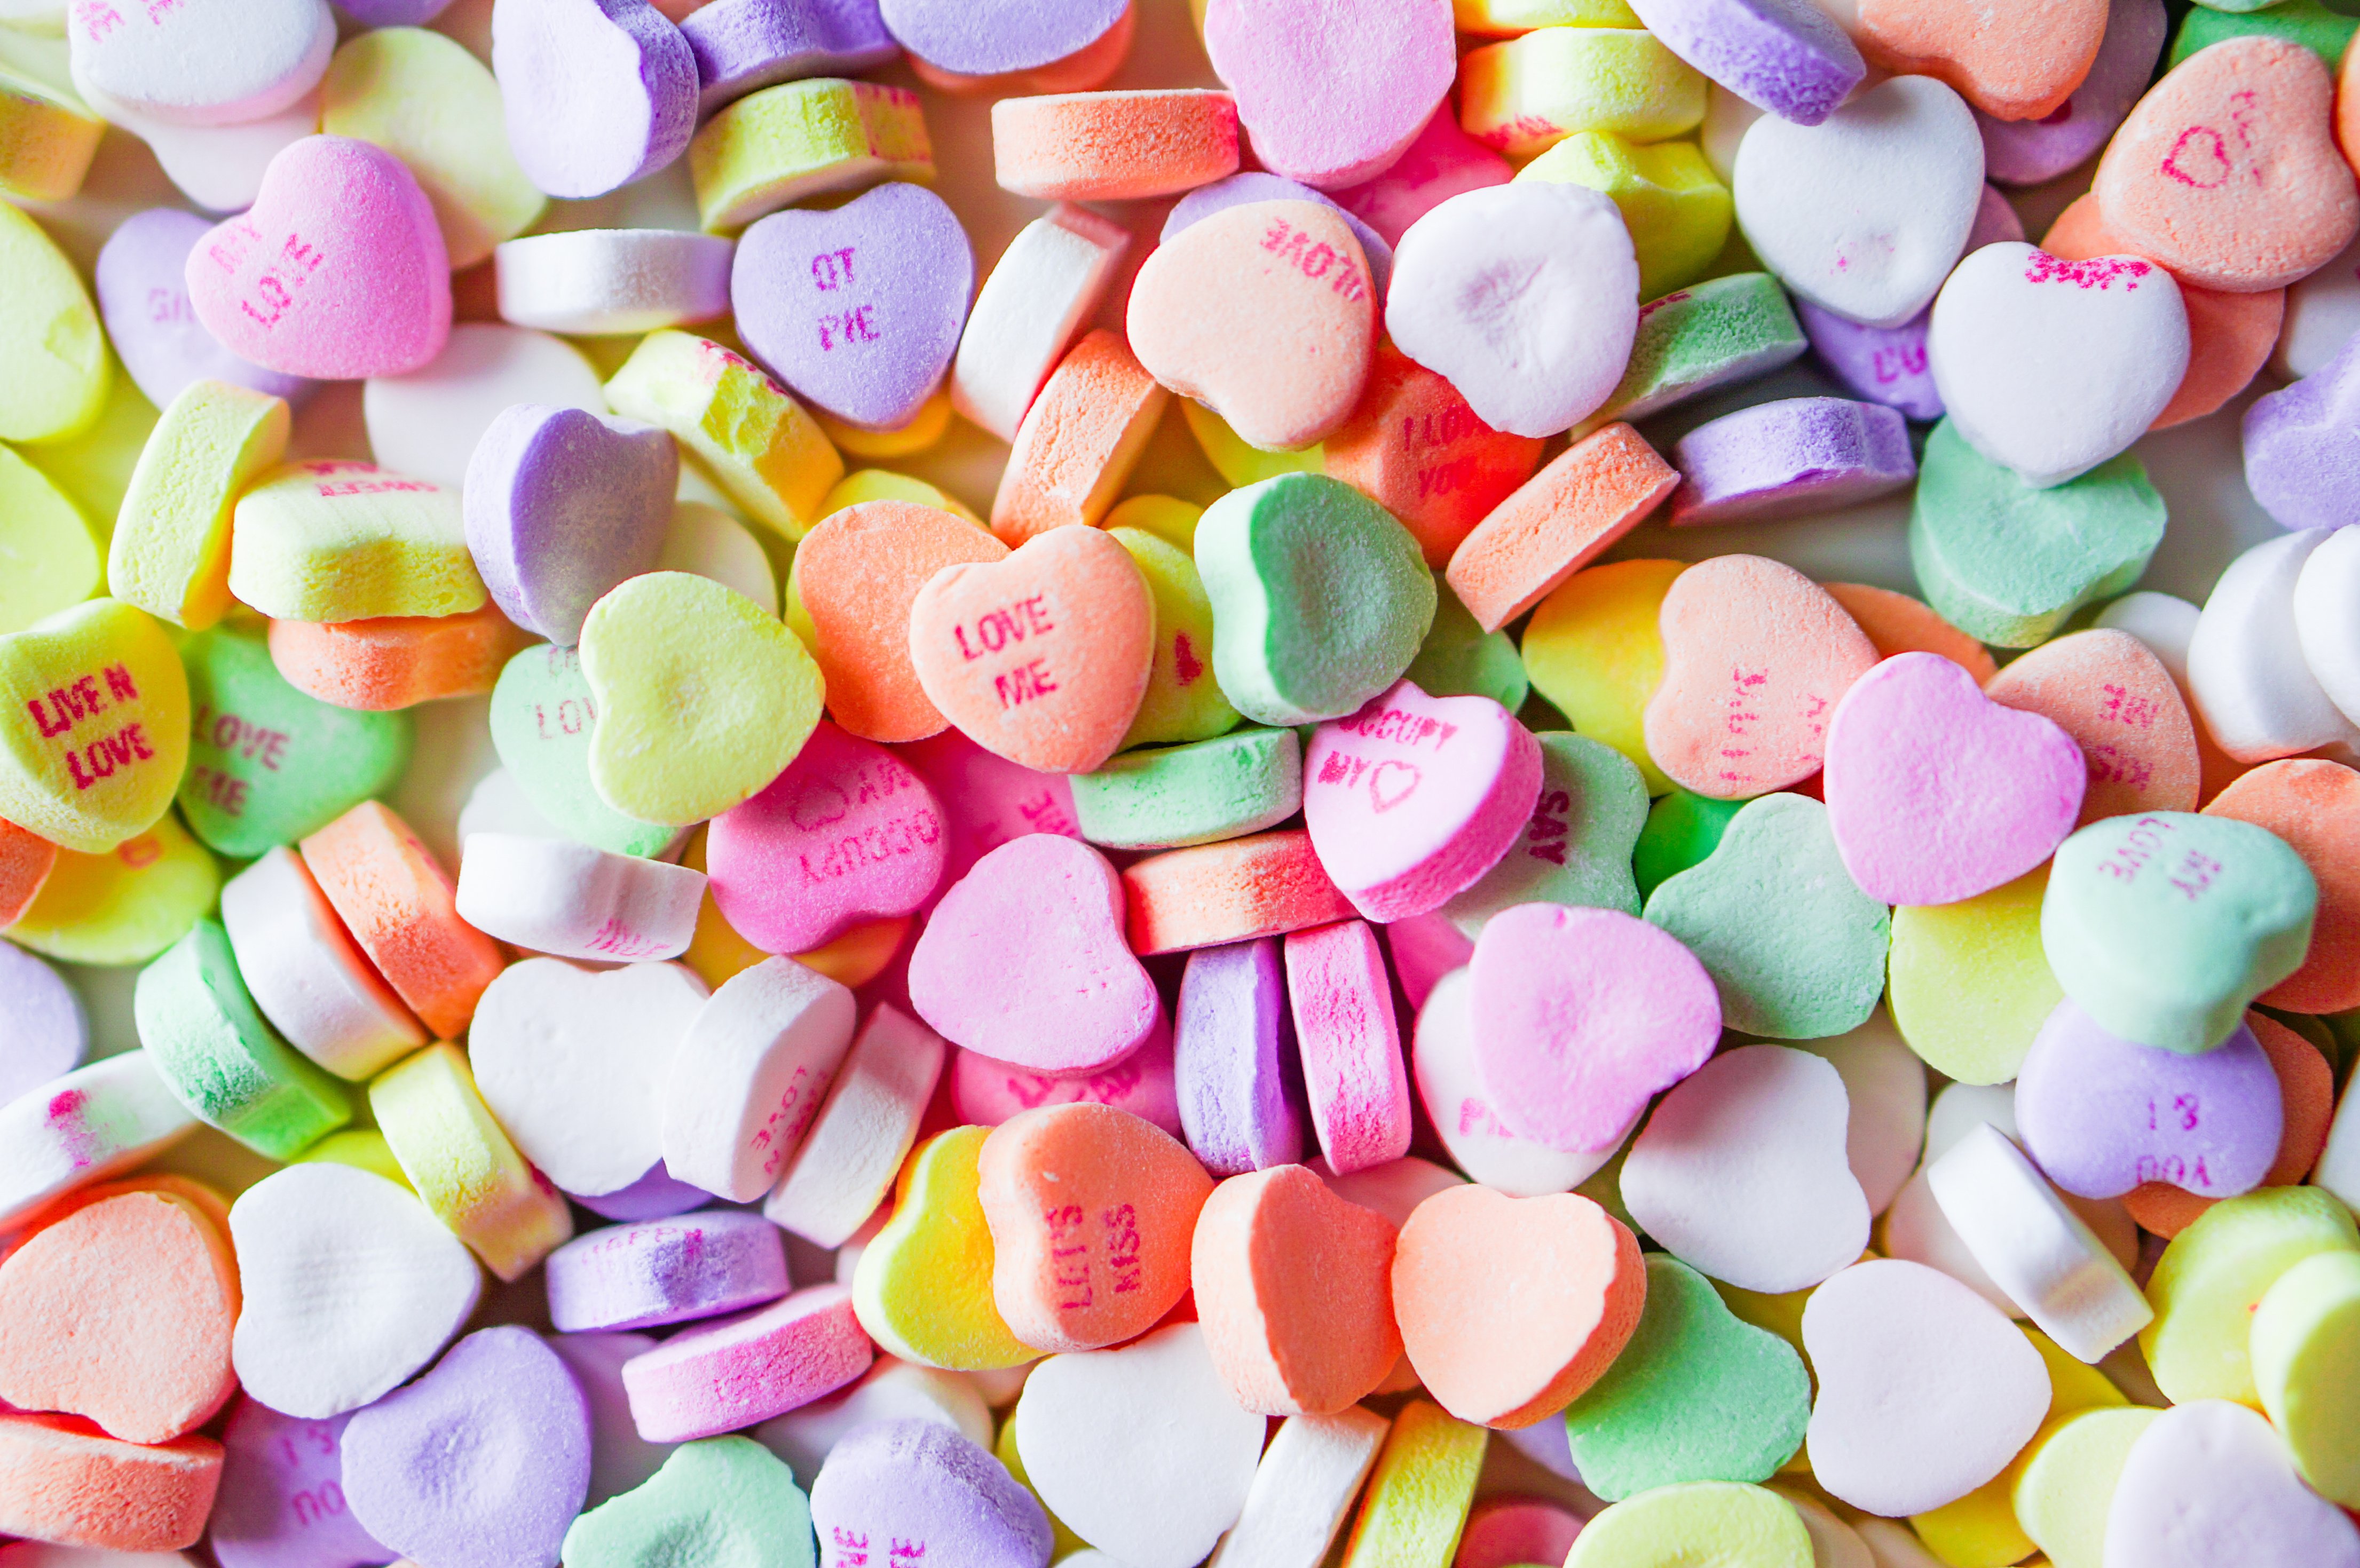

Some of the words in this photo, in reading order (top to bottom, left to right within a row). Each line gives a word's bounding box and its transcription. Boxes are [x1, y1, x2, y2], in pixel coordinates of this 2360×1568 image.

[1260, 218, 1355, 291] LOVE
[817, 305, 881, 352] PIE
[952, 593, 1054, 664] LOVE
[28, 673, 107, 739] LIVE
[103, 661, 139, 703] N
[534, 696, 596, 740] LOV
[995, 658, 1059, 710] ME
[66, 722, 155, 790] LOVE
[192, 703, 291, 771] LOVE
[1338, 706, 1458, 750] OCCUPY
[1317, 750, 1369, 789] MY
[1528, 789, 1570, 866] SAY
[2098, 817, 2176, 883] LOVE
[749, 1065, 810, 1151] LOVE
[1103, 1202, 1141, 1294] KISS
